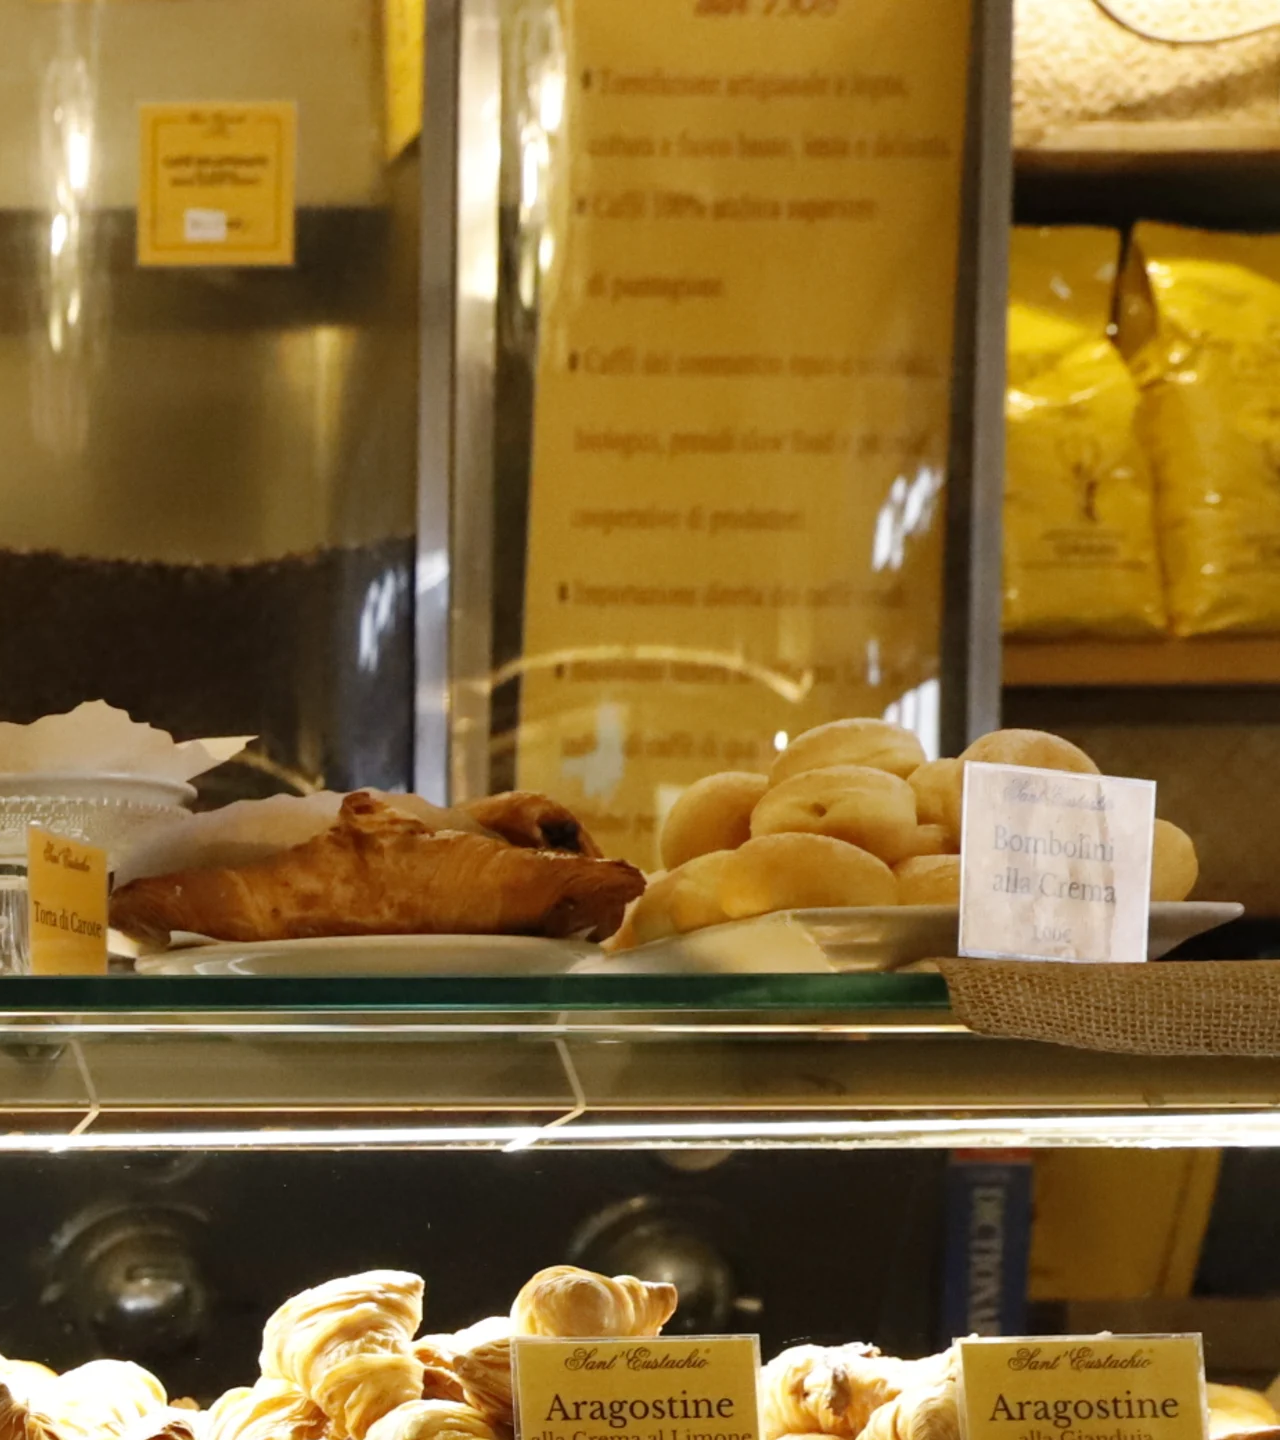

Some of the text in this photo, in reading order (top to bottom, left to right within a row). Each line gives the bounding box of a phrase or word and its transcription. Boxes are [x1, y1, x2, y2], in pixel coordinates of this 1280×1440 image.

[1038, 873, 1117, 903] Crema
[545, 1390, 735, 1429] Aragostine
[989, 1390, 1180, 1429] Aragostine
